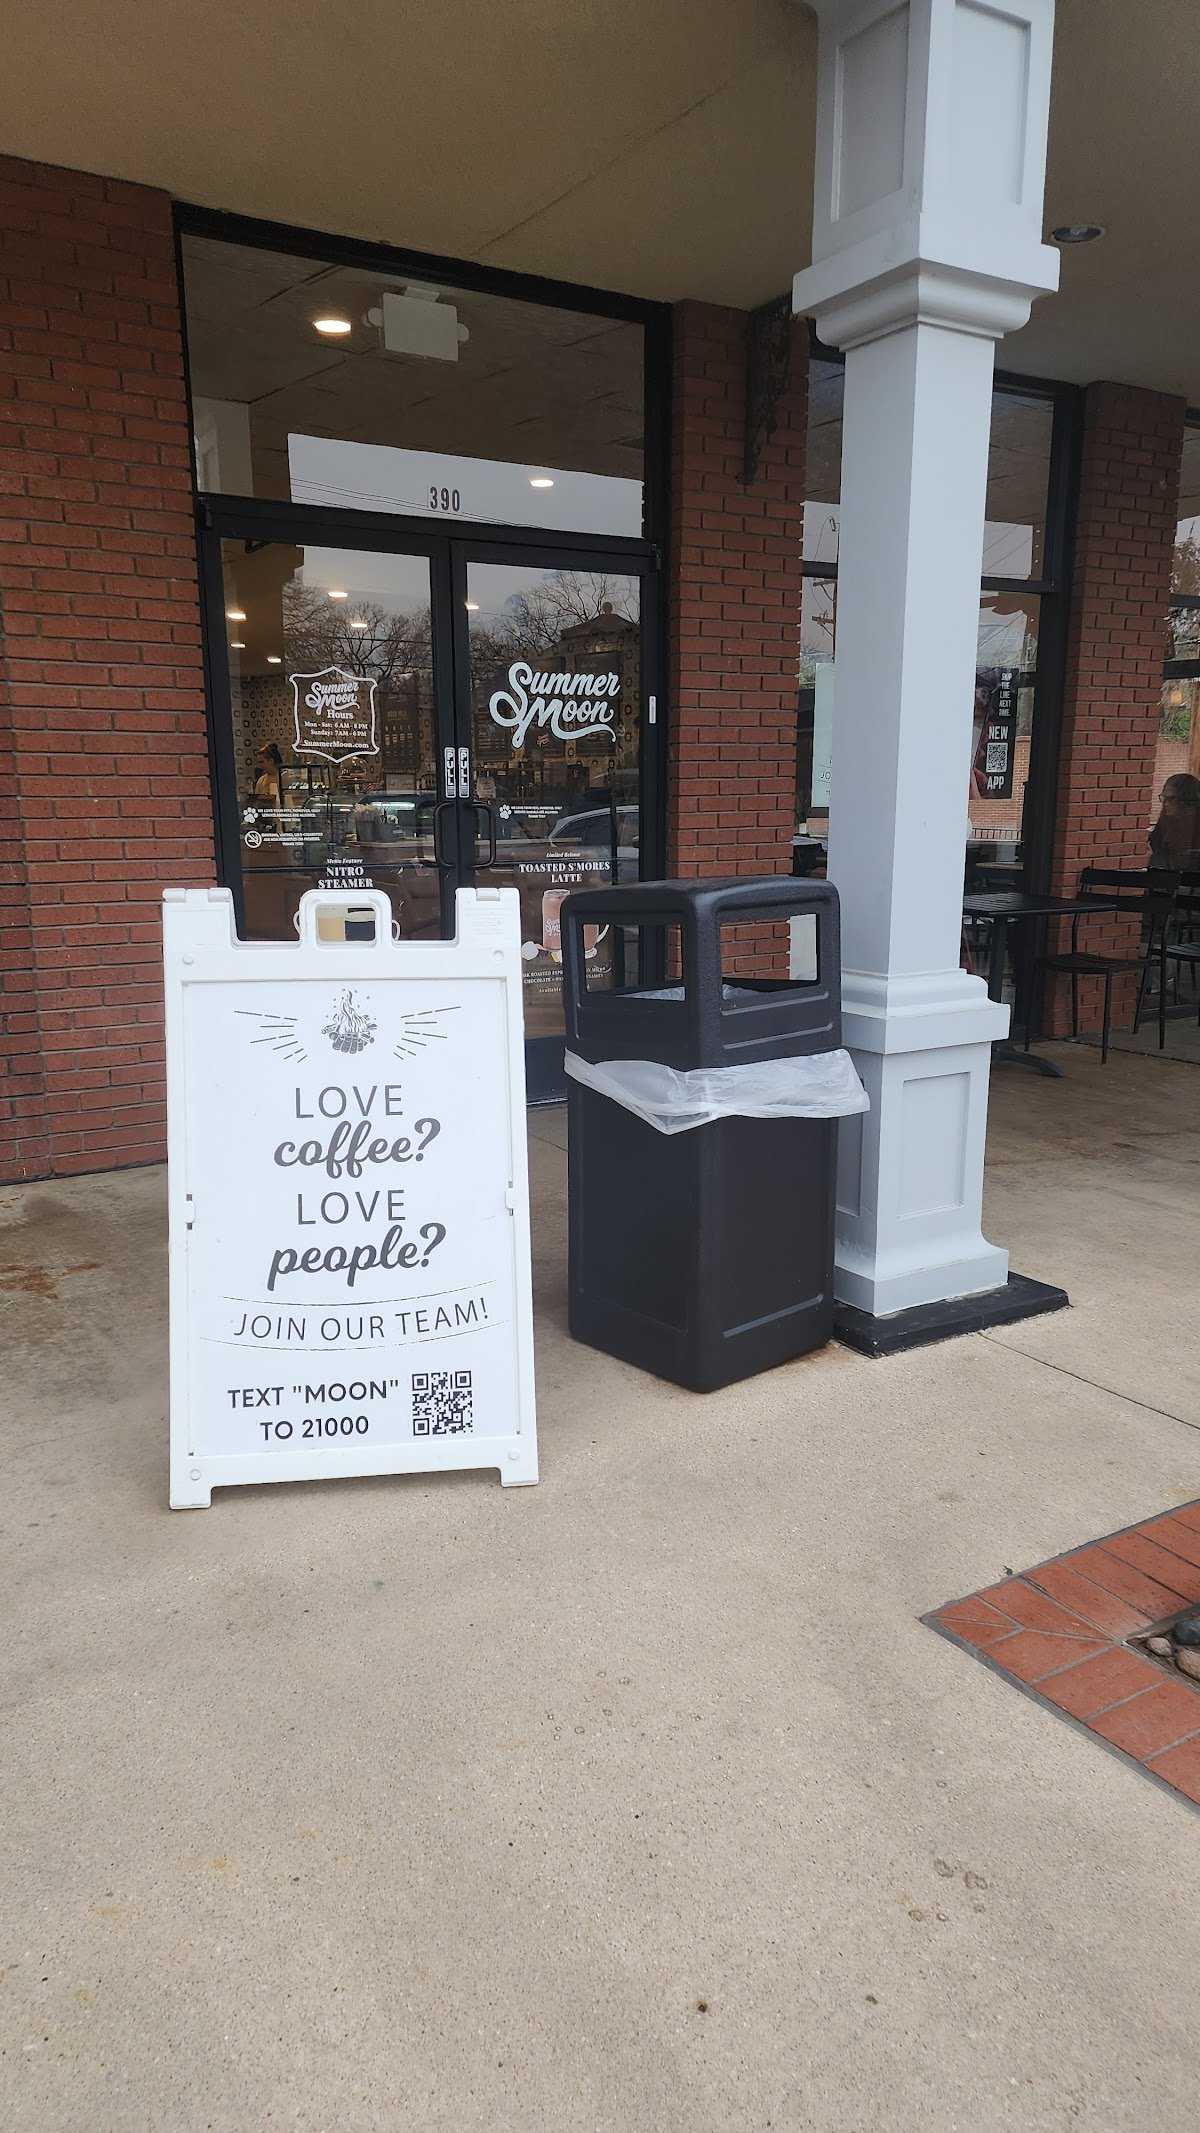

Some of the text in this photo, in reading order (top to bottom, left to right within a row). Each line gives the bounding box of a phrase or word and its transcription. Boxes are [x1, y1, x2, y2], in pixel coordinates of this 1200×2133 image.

[430, 486, 460, 512] 390
[304, 720, 318, 728] Mon
[327, 709, 354, 719] Hours
[310, 729, 333, 737] Sunday:
[988, 726, 1009, 740] NEW
[303, 740, 369, 749] SummerMoon.com
[446, 752, 454, 786] PULL
[460, 752, 468, 786] PULL
[986, 776, 1005, 790] APP
[326, 866, 364, 877] NITRO
[519, 861, 610, 873] TOASTED S'MORES
[318, 878, 374, 889] STEAMER
[551, 873, 582, 883] LATTE
[296, 1085, 403, 1118] LOVE
[274, 1118, 441, 1179] coffee?
[298, 1190, 406, 1225] LOVE
[267, 1223, 447, 1292] people?
[234, 1297, 489, 1341] JOIN OUR TEAM!
[228, 1379, 399, 1409] TEXT "MOON"
[260, 1415, 369, 1441] TO 21000
